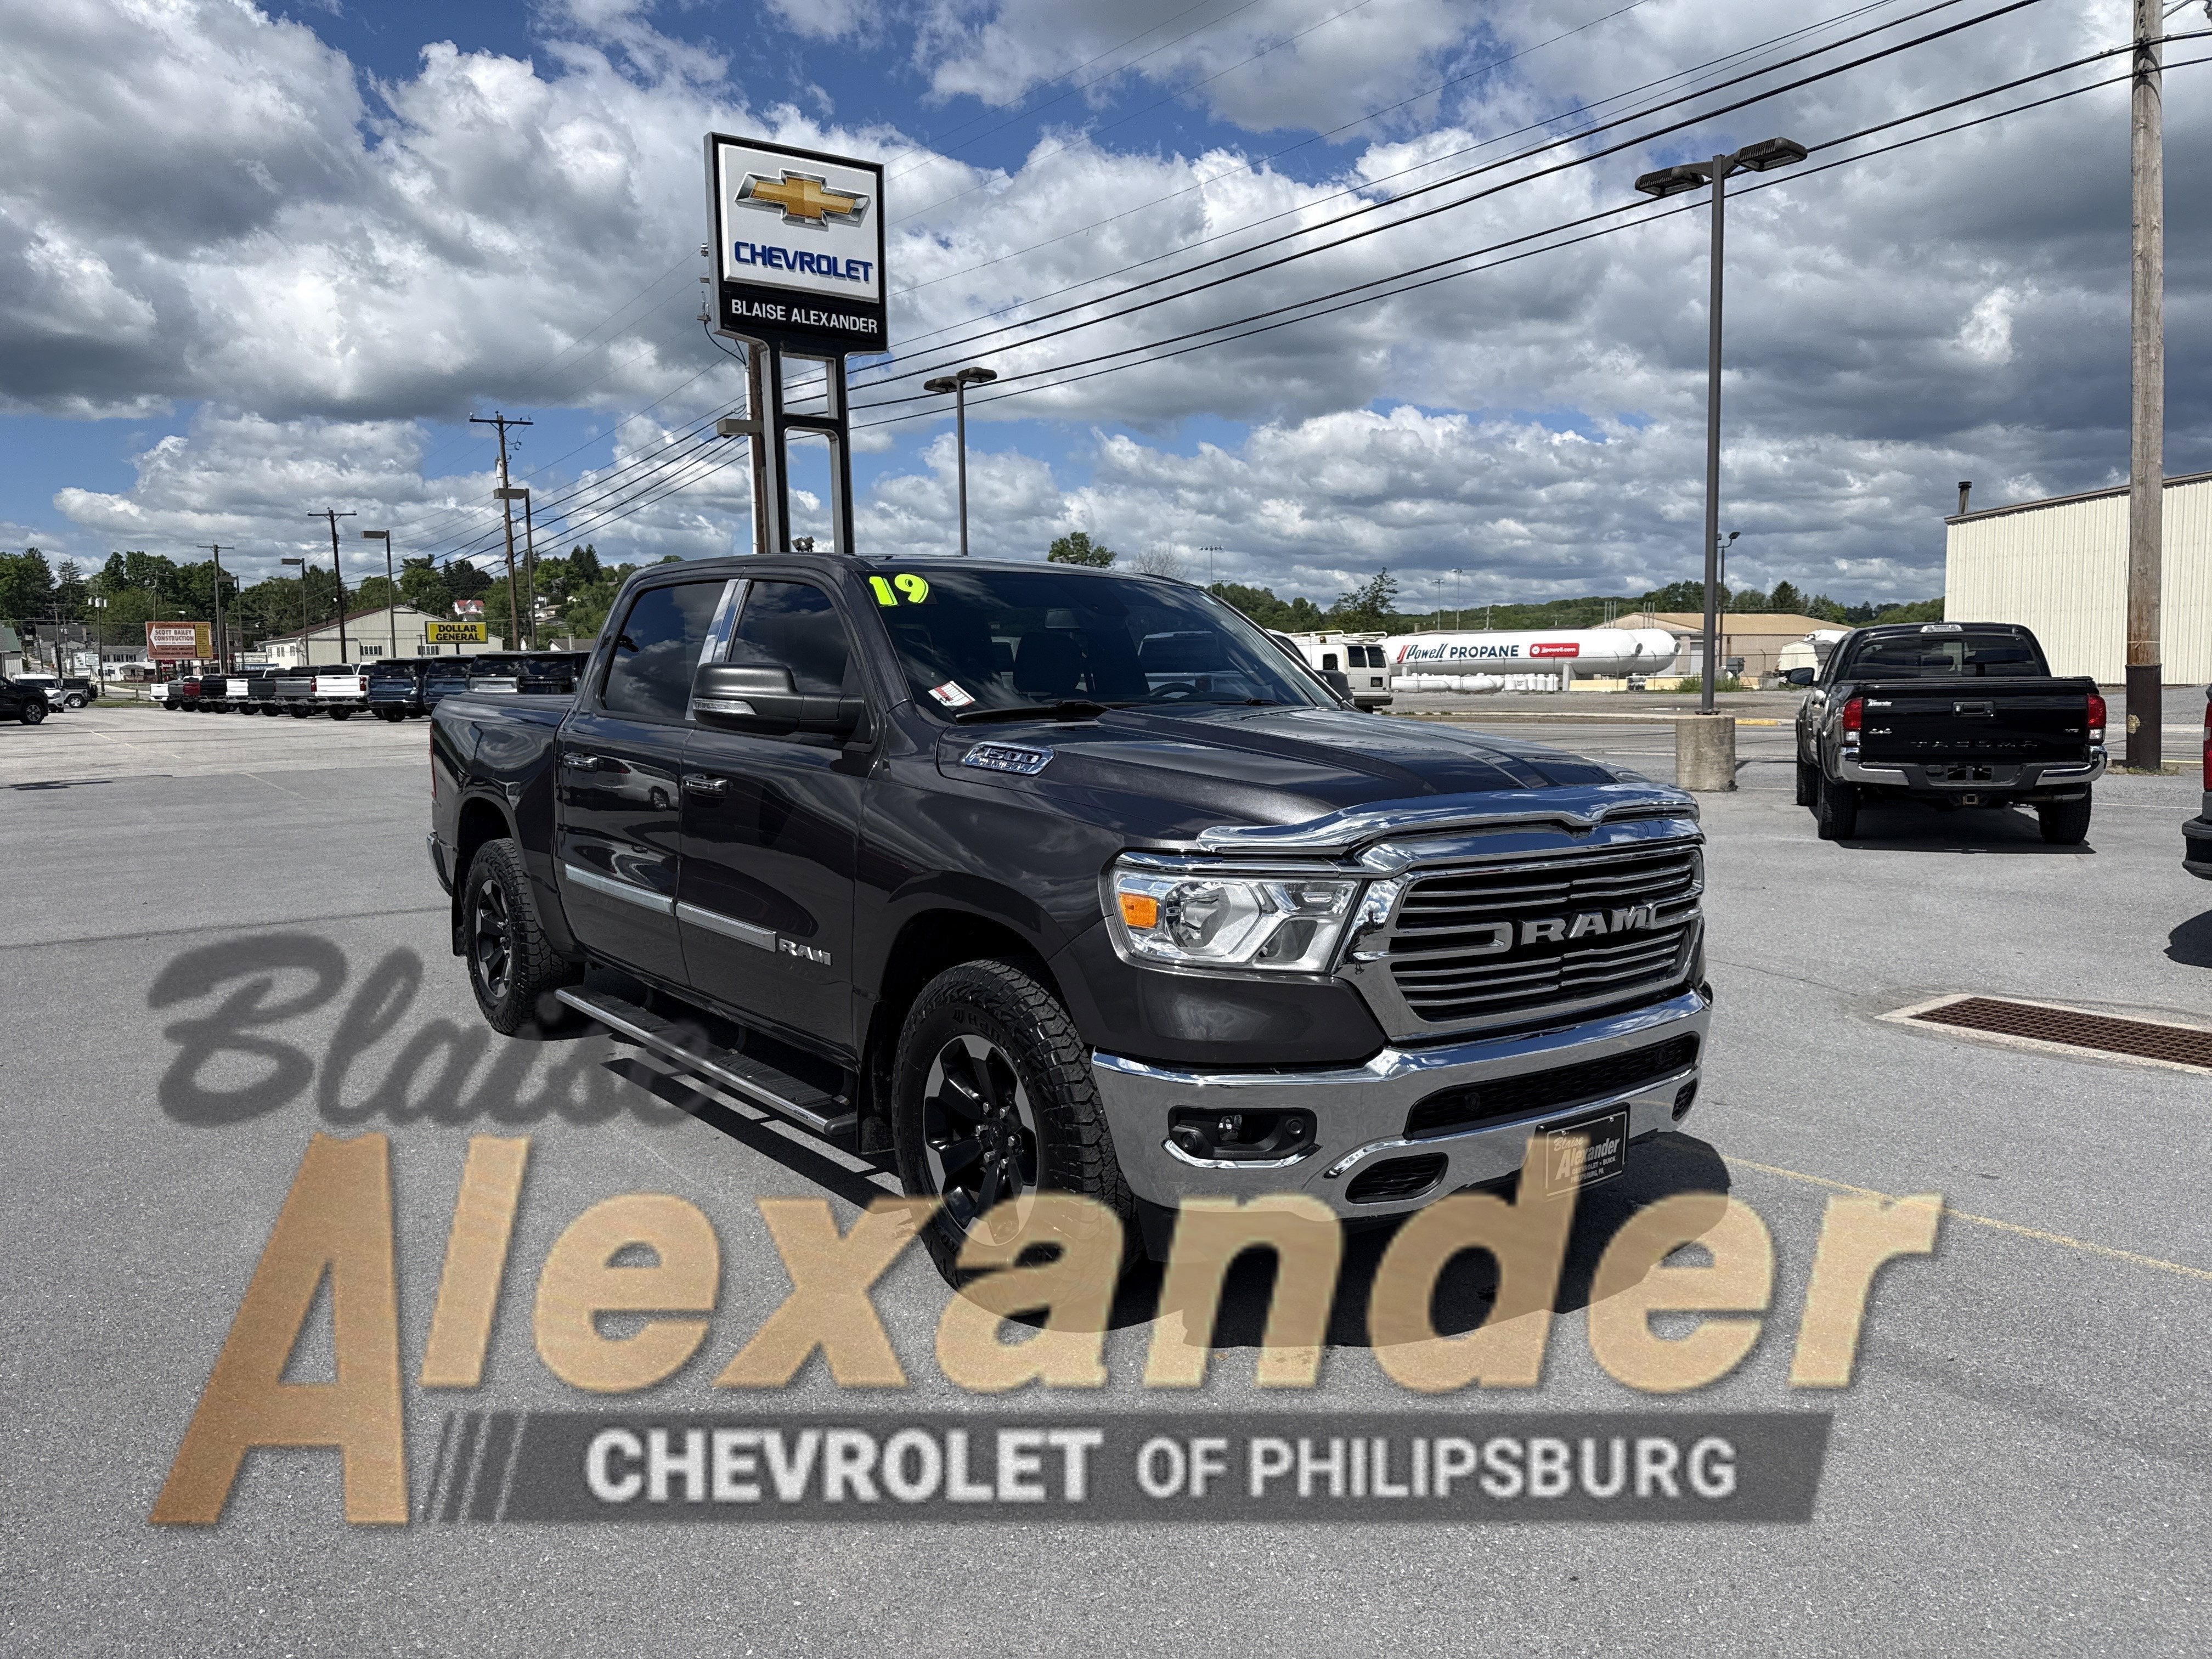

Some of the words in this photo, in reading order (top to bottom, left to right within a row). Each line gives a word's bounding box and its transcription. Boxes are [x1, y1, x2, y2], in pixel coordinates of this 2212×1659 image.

[734, 241, 873, 282] CHEVROLET
[731, 298, 787, 321] BLAISE
[791, 308, 878, 334] ALEXANDER
[869, 573, 929, 606] 19
[436, 633, 481, 641] GENERAL
[1450, 645, 1520, 658] PROPANE
[981, 747, 1040, 764] 1500
[1519, 906, 1647, 945] RAM
[779, 938, 832, 966] RAM
[1554, 1136, 1584, 1152] Blaise
[1555, 1137, 1621, 1181] Alexander
[1571, 1161, 1599, 1175] CHEVROLET
